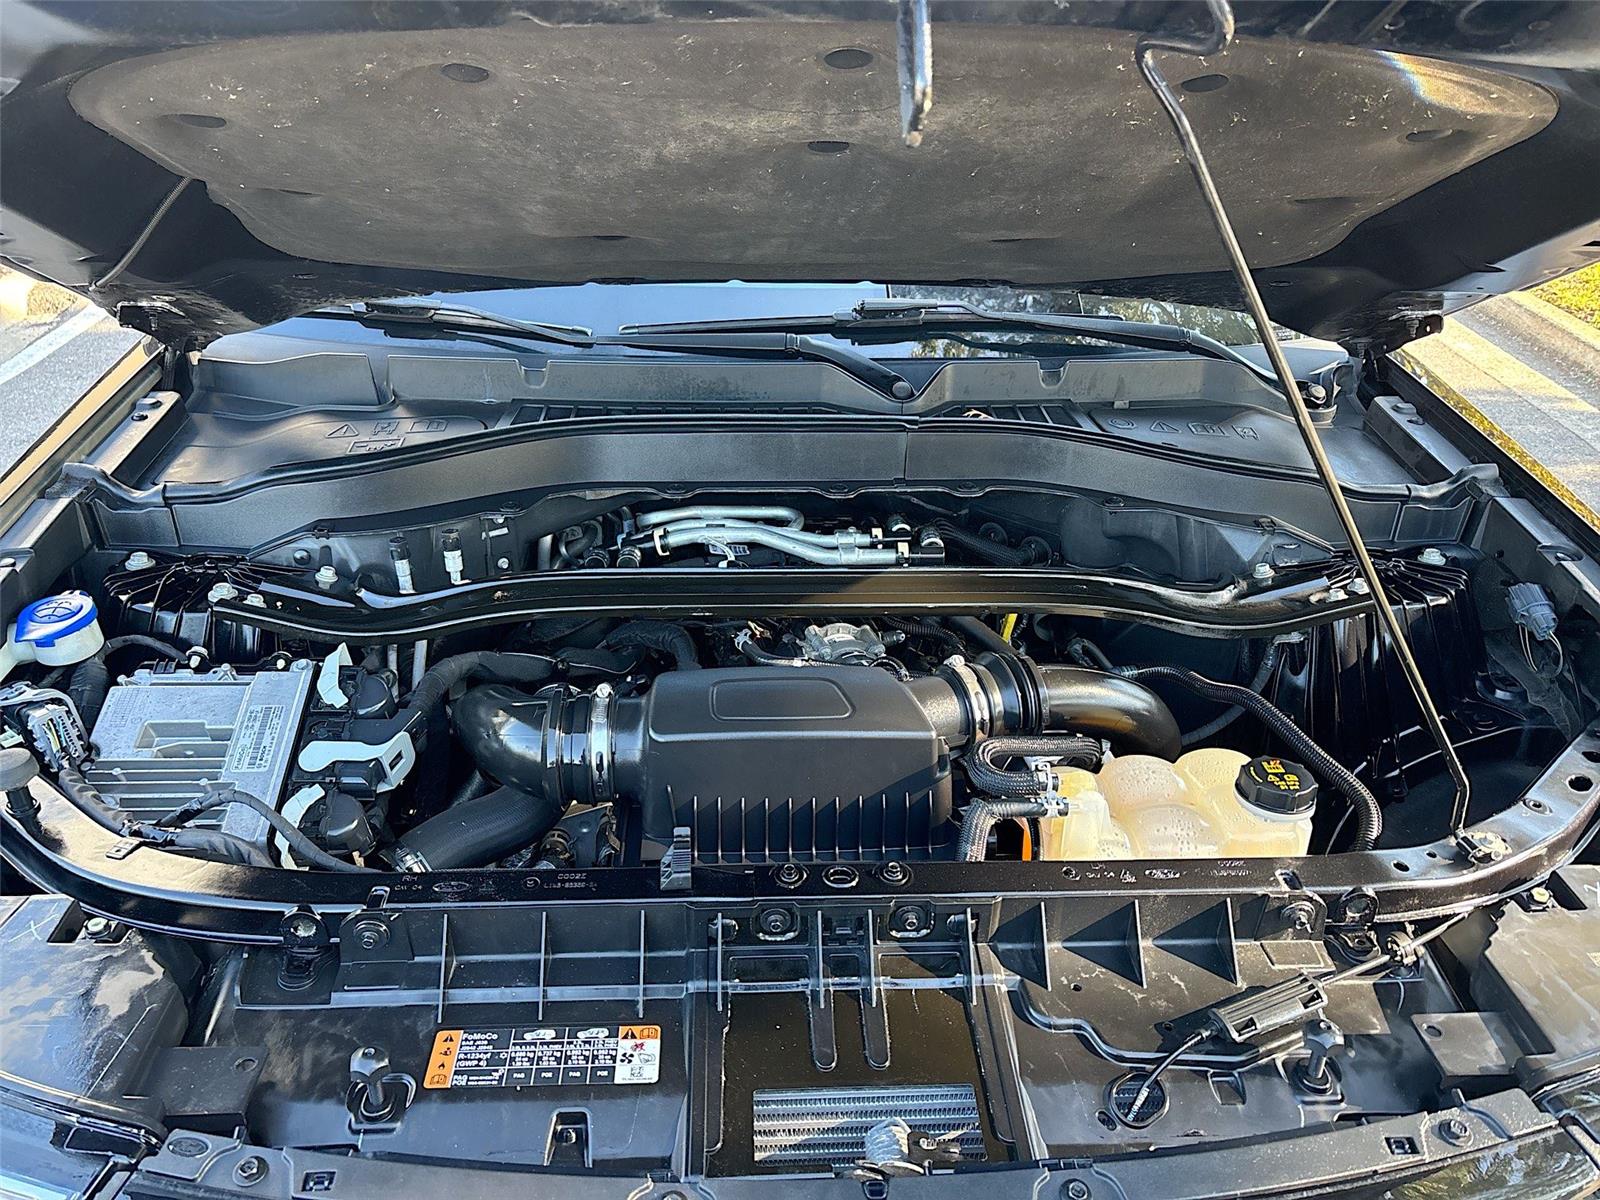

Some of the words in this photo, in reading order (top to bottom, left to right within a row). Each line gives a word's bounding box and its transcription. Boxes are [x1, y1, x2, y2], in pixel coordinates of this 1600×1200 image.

[462, 1032, 498, 1040] FoMoCo
[456, 1060, 479, 1068] (GWP
[479, 1060, 488, 1068] 4)
